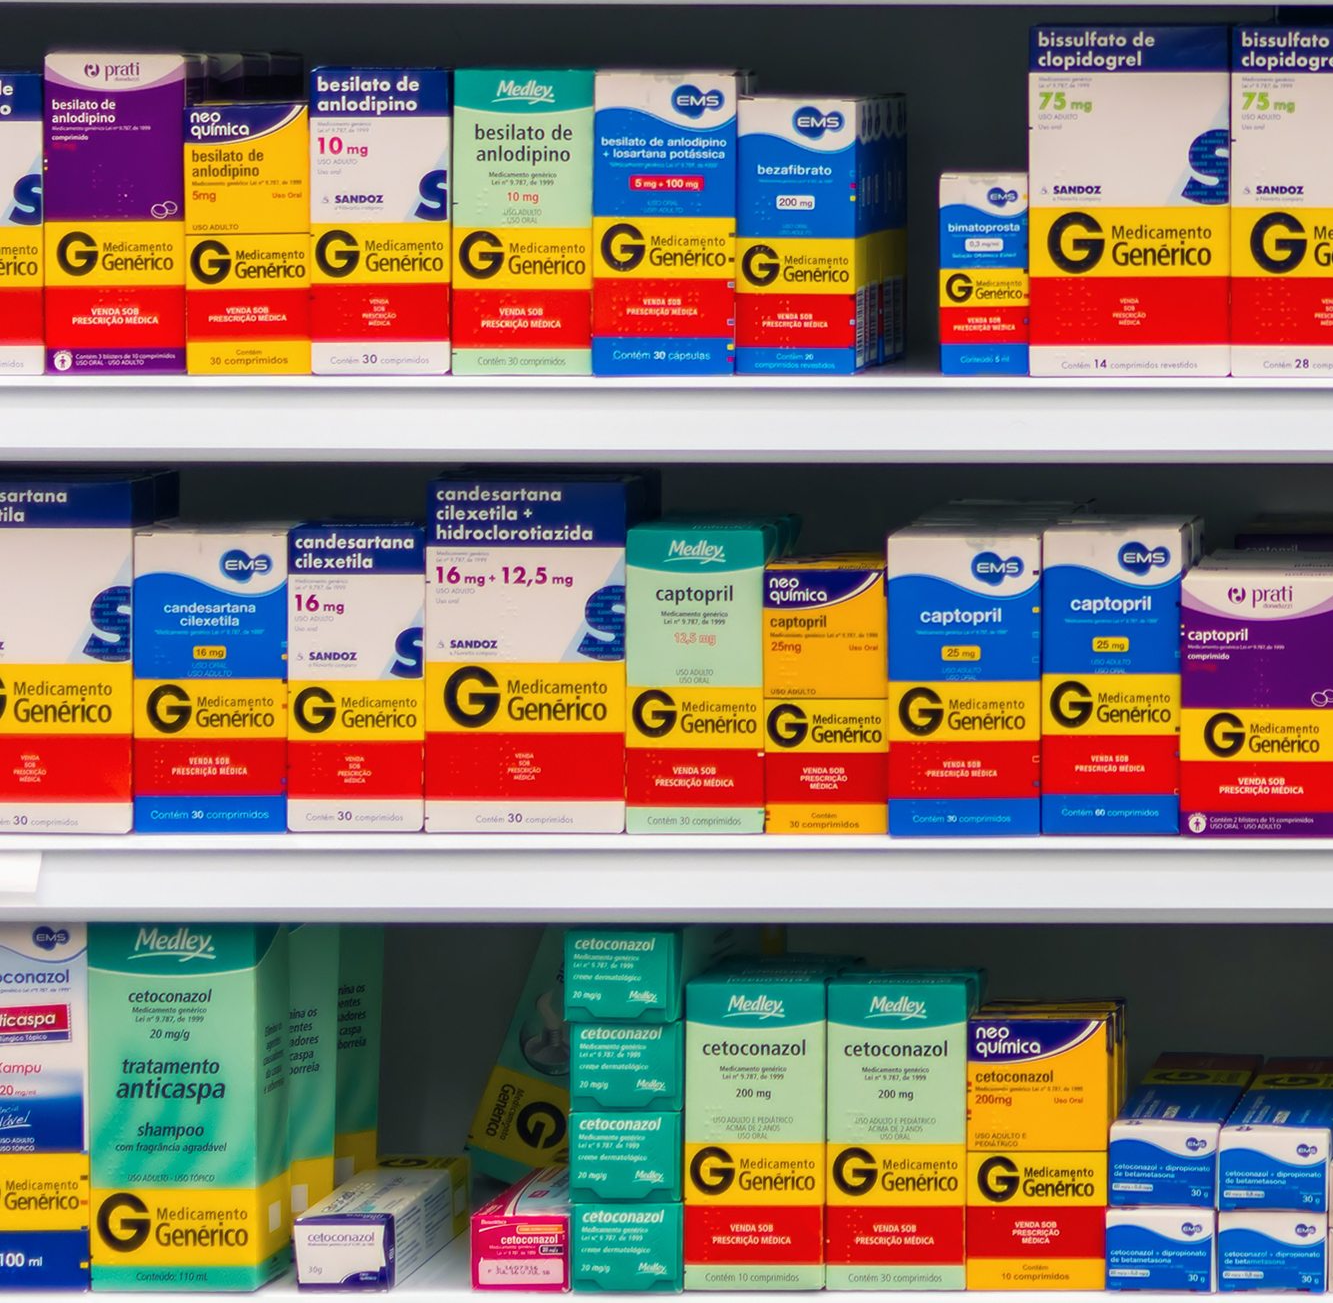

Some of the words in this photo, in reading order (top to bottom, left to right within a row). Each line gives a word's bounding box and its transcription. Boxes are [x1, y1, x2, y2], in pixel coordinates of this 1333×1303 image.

[1038, 30, 1127, 48] bissulfato
[1132, 30, 1155, 47] de
[1037, 50, 1142, 71] clopidogrel
[757, 163, 833, 176] bezafibrato
[947, 222, 1021, 234] bimatoprosta
[436, 485, 562, 502] candesartana
[436, 523, 593, 541] hidroclorotiazida
[435, 565, 461, 585] 16
[464, 575, 486, 588] mg
[501, 565, 548, 587] 12,5
[551, 576, 574, 588] mg
[655, 584, 734, 606] captopril
[920, 607, 1002, 627] captopril
[976, 1027, 1009, 1039] neo
[976, 1038, 1040, 1057] química
[122, 1058, 220, 1075] tratamento
[975, 1069, 1054, 1083] cetoconazol
[116, 1079, 226, 1105] anticaspa
[137, 1121, 205, 1141] shampoo
[115, 1143, 134, 1152] com
[136, 1142, 181, 1154] fragrância
[182, 1142, 227, 1154] agradável
[307, 1231, 375, 1243] cetoconazol
